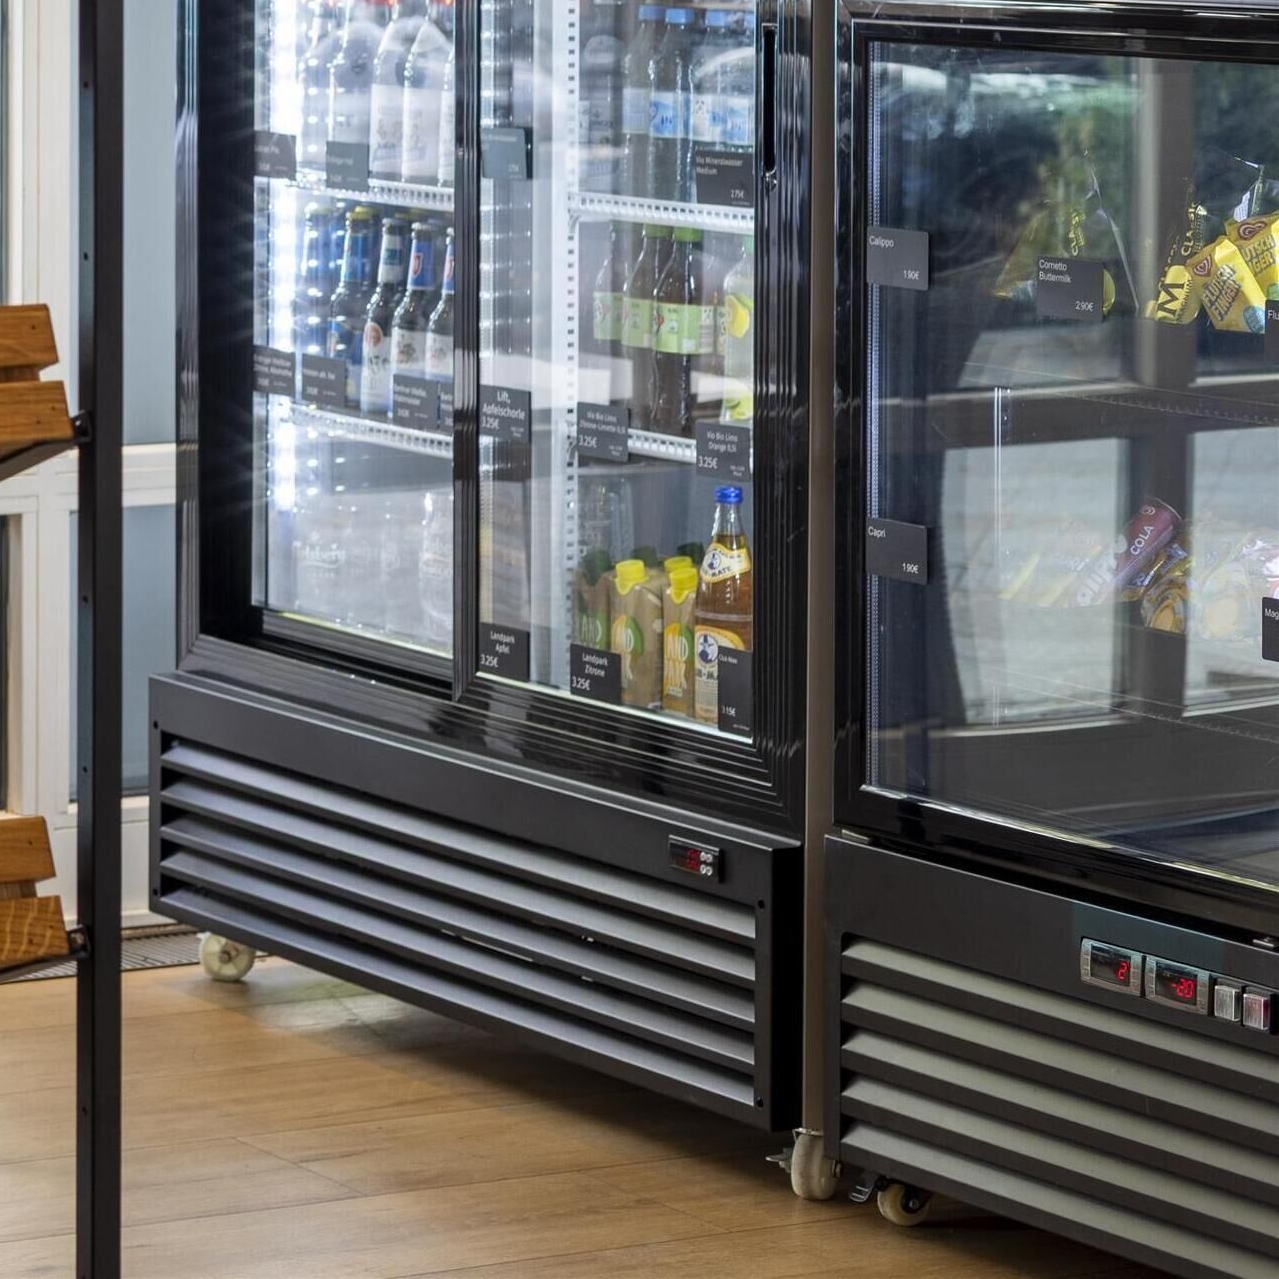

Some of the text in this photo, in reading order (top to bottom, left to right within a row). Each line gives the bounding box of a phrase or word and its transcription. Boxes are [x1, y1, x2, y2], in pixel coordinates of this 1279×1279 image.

[869, 235, 894, 248] Calippo
[1241, 233, 1277, 262] UTSCH
[1038, 259, 1068, 272] Cornetto
[1038, 270, 1072, 283] Buttermilk
[497, 390, 511, 404] Lift,
[483, 402, 525, 421] Apfelschorle
[706, 430, 715, 440] Vio
[716, 432, 724, 441] Bio
[708, 442, 726, 454] Orange
[868, 525, 886, 538] Capri
[1130, 525, 1154, 555] COLA
[490, 631, 515, 644] Landpark
[495, 643, 510, 655] Apfel
[582, 652, 609, 666] Landpark
[585, 664, 605, 678] Zitrone
[1118, 961, 1130, 980] 2
[1172, 978, 1196, 998] -20
